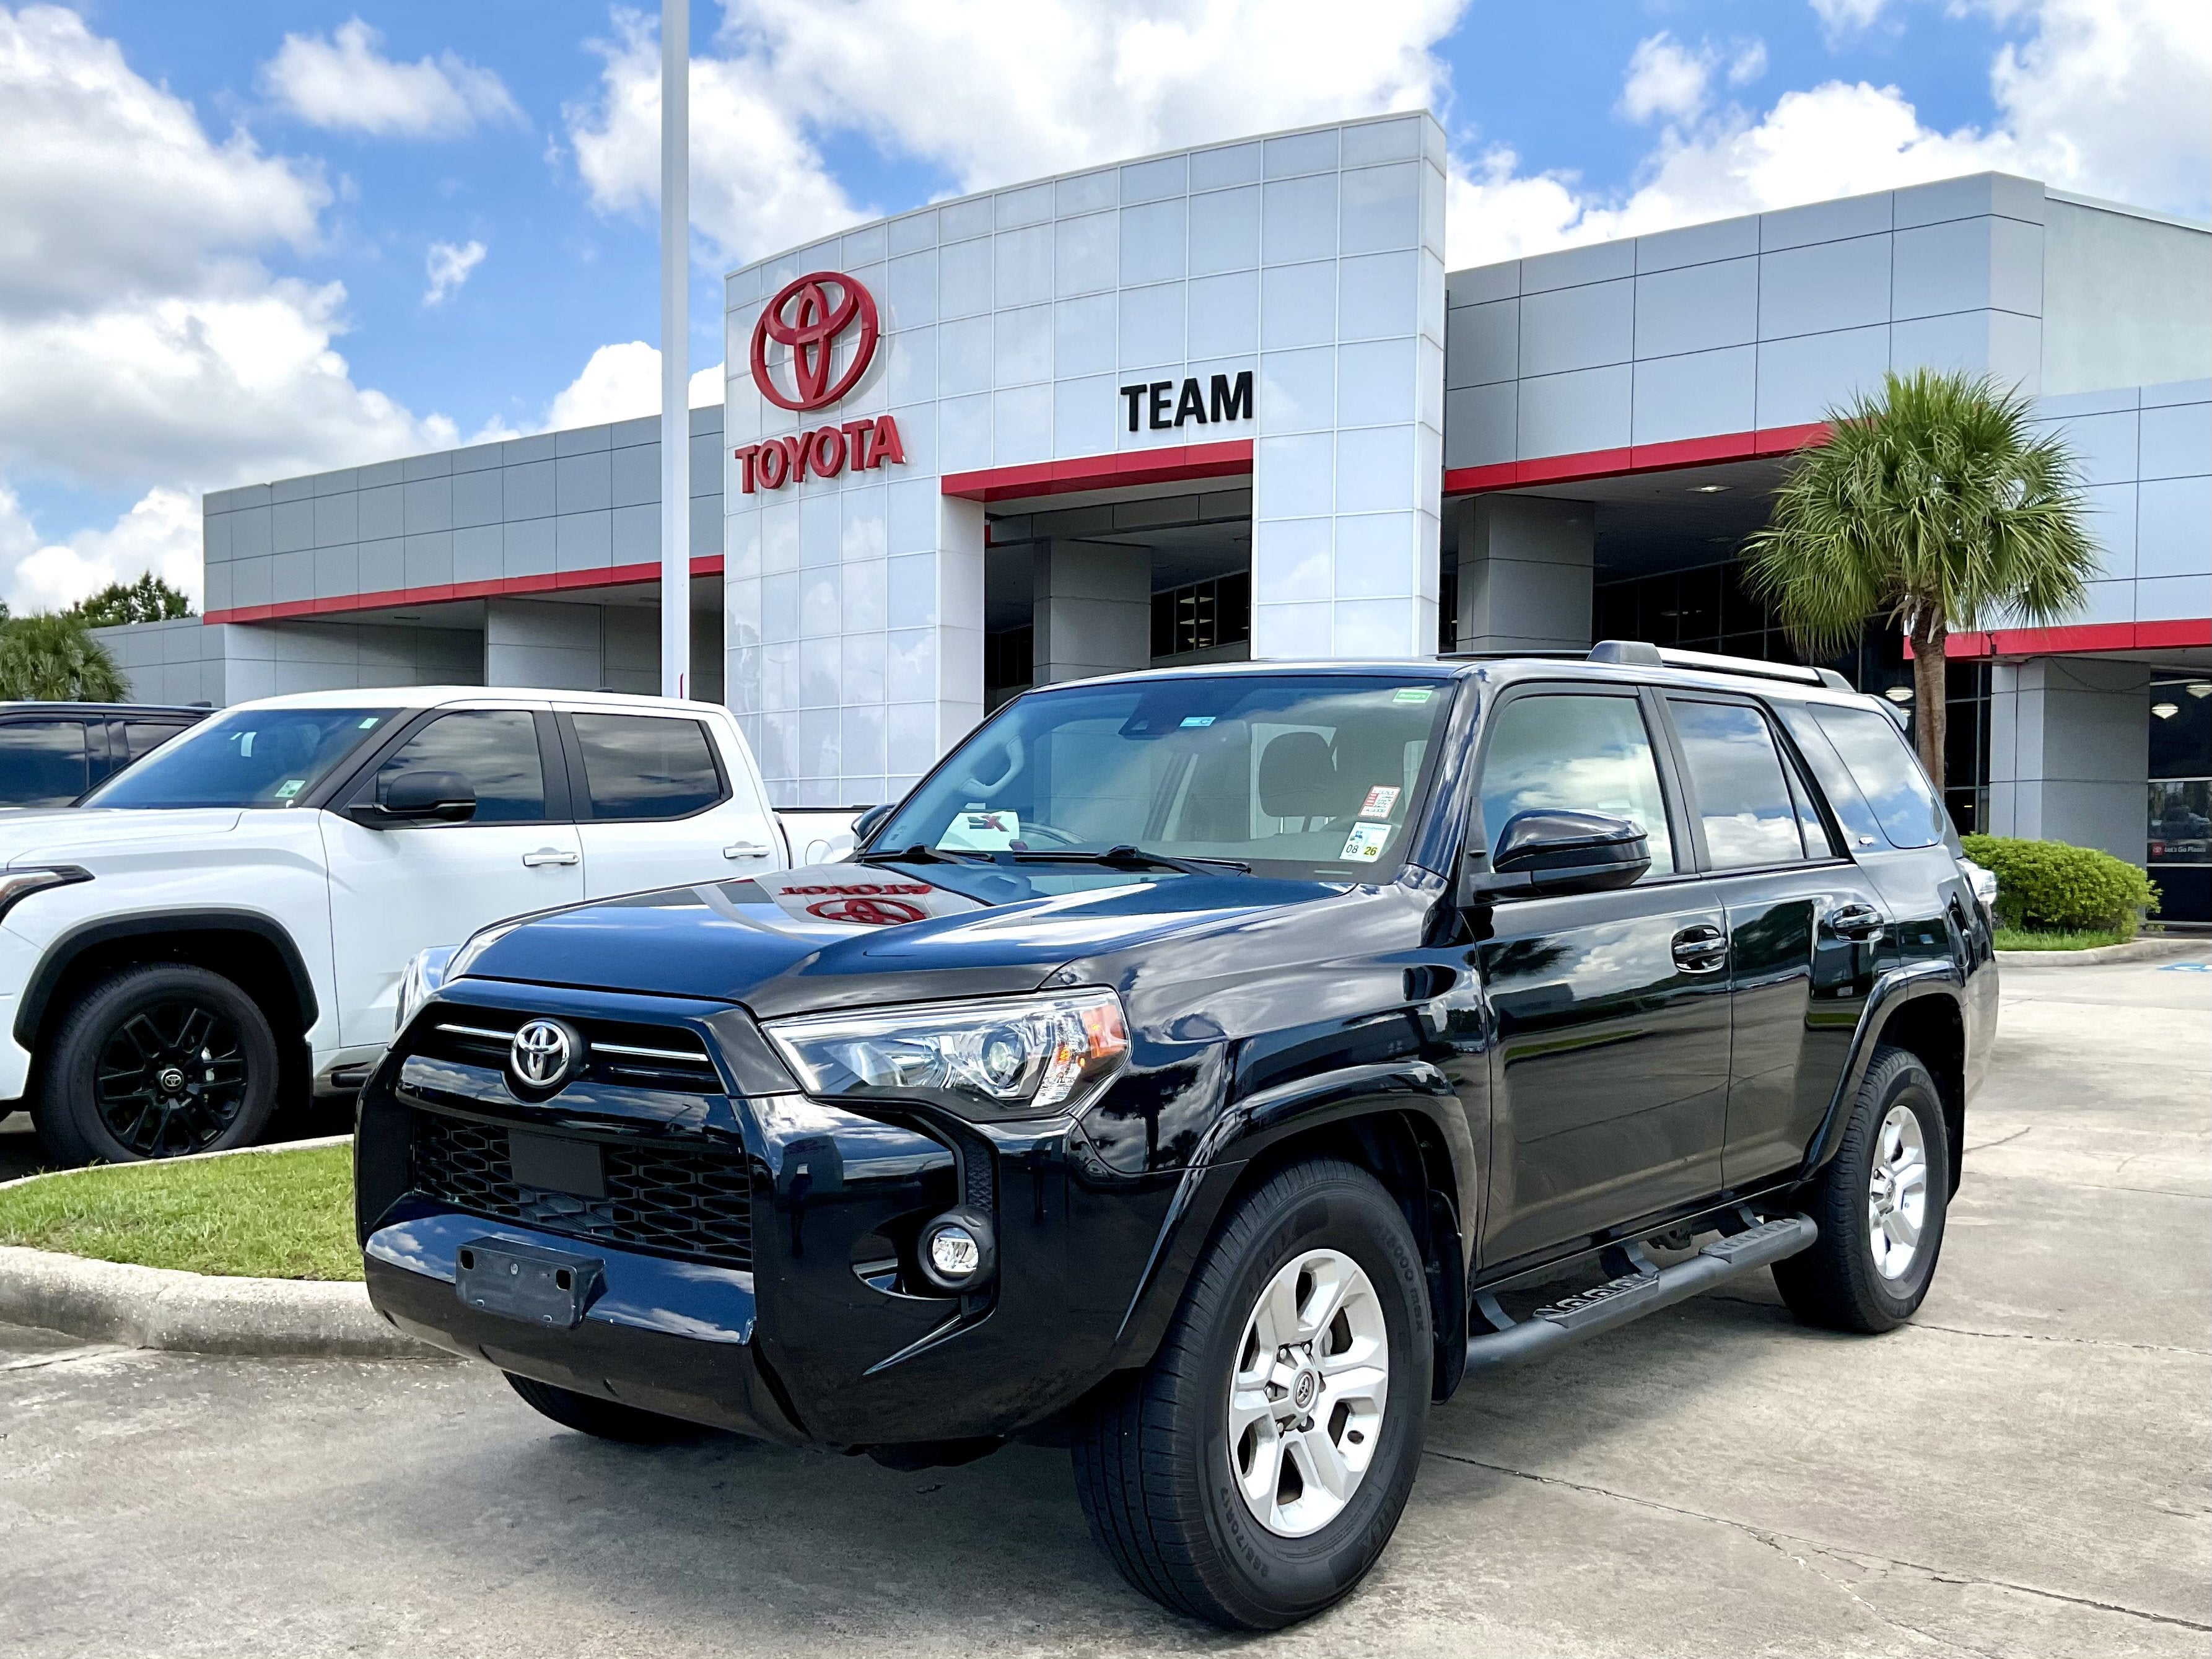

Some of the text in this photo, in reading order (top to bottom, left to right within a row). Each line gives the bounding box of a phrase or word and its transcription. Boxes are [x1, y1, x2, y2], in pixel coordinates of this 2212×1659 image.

[1120, 370, 1253, 432] TEAM
[735, 414, 905, 494] TOYOTA
[1346, 844, 1378, 856] 08 26
